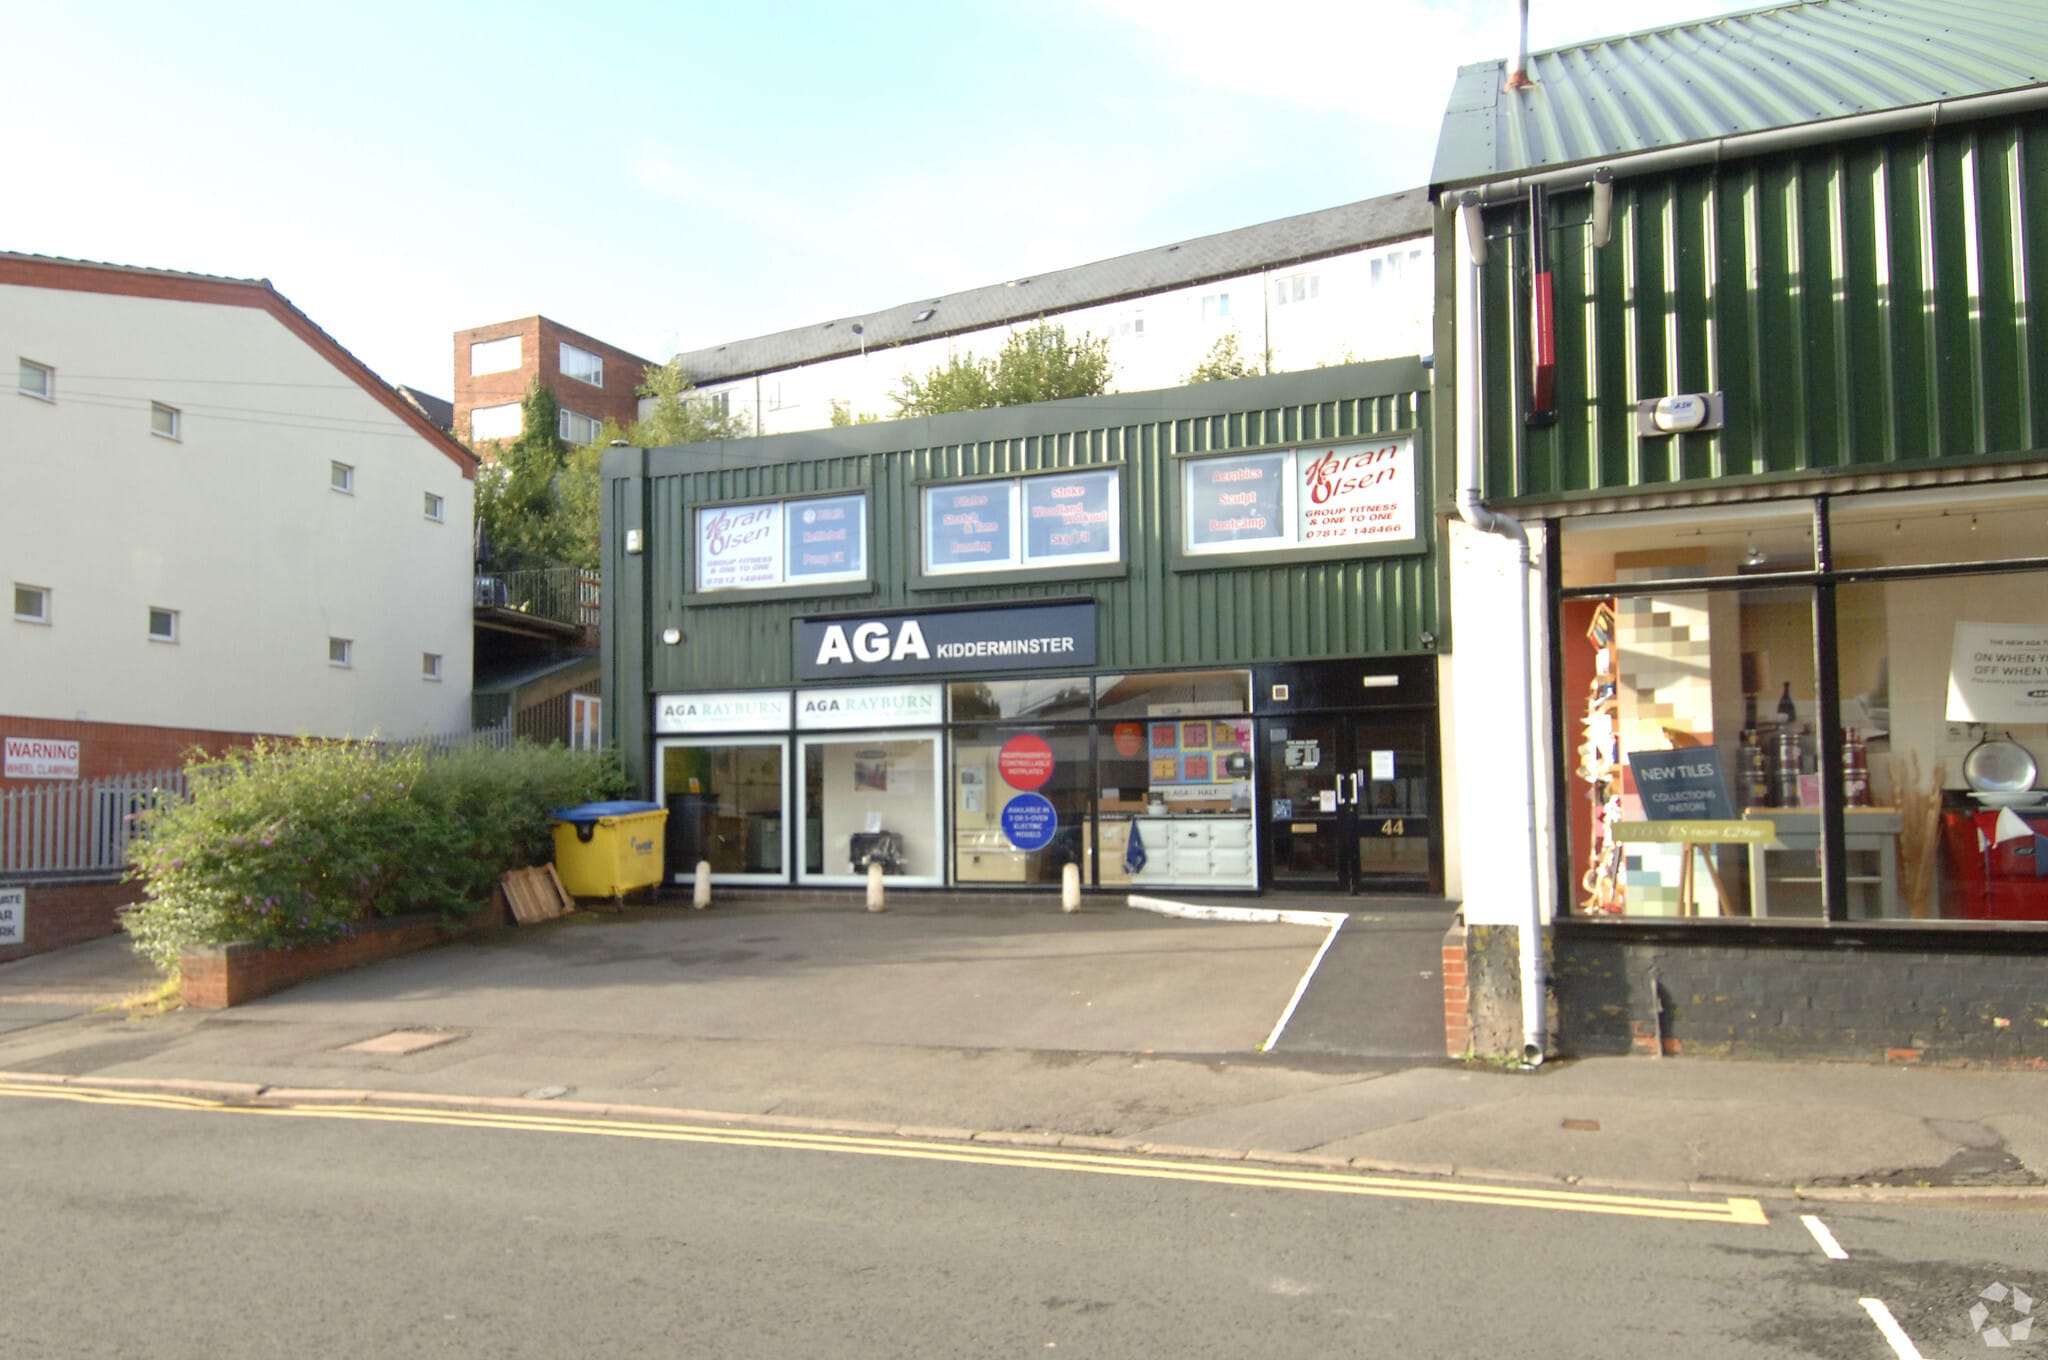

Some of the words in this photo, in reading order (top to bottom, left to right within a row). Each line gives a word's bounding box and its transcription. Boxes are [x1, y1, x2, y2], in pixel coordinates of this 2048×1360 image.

[1053, 486, 1085, 498] Strike
[1311, 467, 1395, 504] Olsen
[1305, 507, 1346, 518] GROUP
[1350, 503, 1397, 514] FITNESS
[1309, 518, 1318, 526] &
[1322, 516, 1346, 525] ONE
[1351, 514, 1365, 523] TO
[1369, 512, 1394, 521] ONE
[709, 526, 771, 556] Olsen
[1306, 528, 1347, 539] 07812
[816, 620, 930, 665] AGA
[937, 637, 1075, 659] KIDDERMINSTER
[1974, 652, 1992, 662] ON
[1996, 653, 2036, 663] WHEN
[1974, 666, 1999, 675] OFF
[2002, 667, 2042, 676] WHEN
[664, 704, 697, 716] AGA
[702, 701, 783, 716] RAYBURN
[805, 699, 840, 713] AGA
[846, 695, 933, 711] RAYBURN
[8, 742, 78, 760] WARNING
[7, 764, 34, 775] WHEEL
[1641, 767, 1675, 781] NEW
[1679, 763, 1714, 778] TILES
[1652, 790, 1716, 802] COLLECTIONS
[1381, 818, 1405, 836] 44
